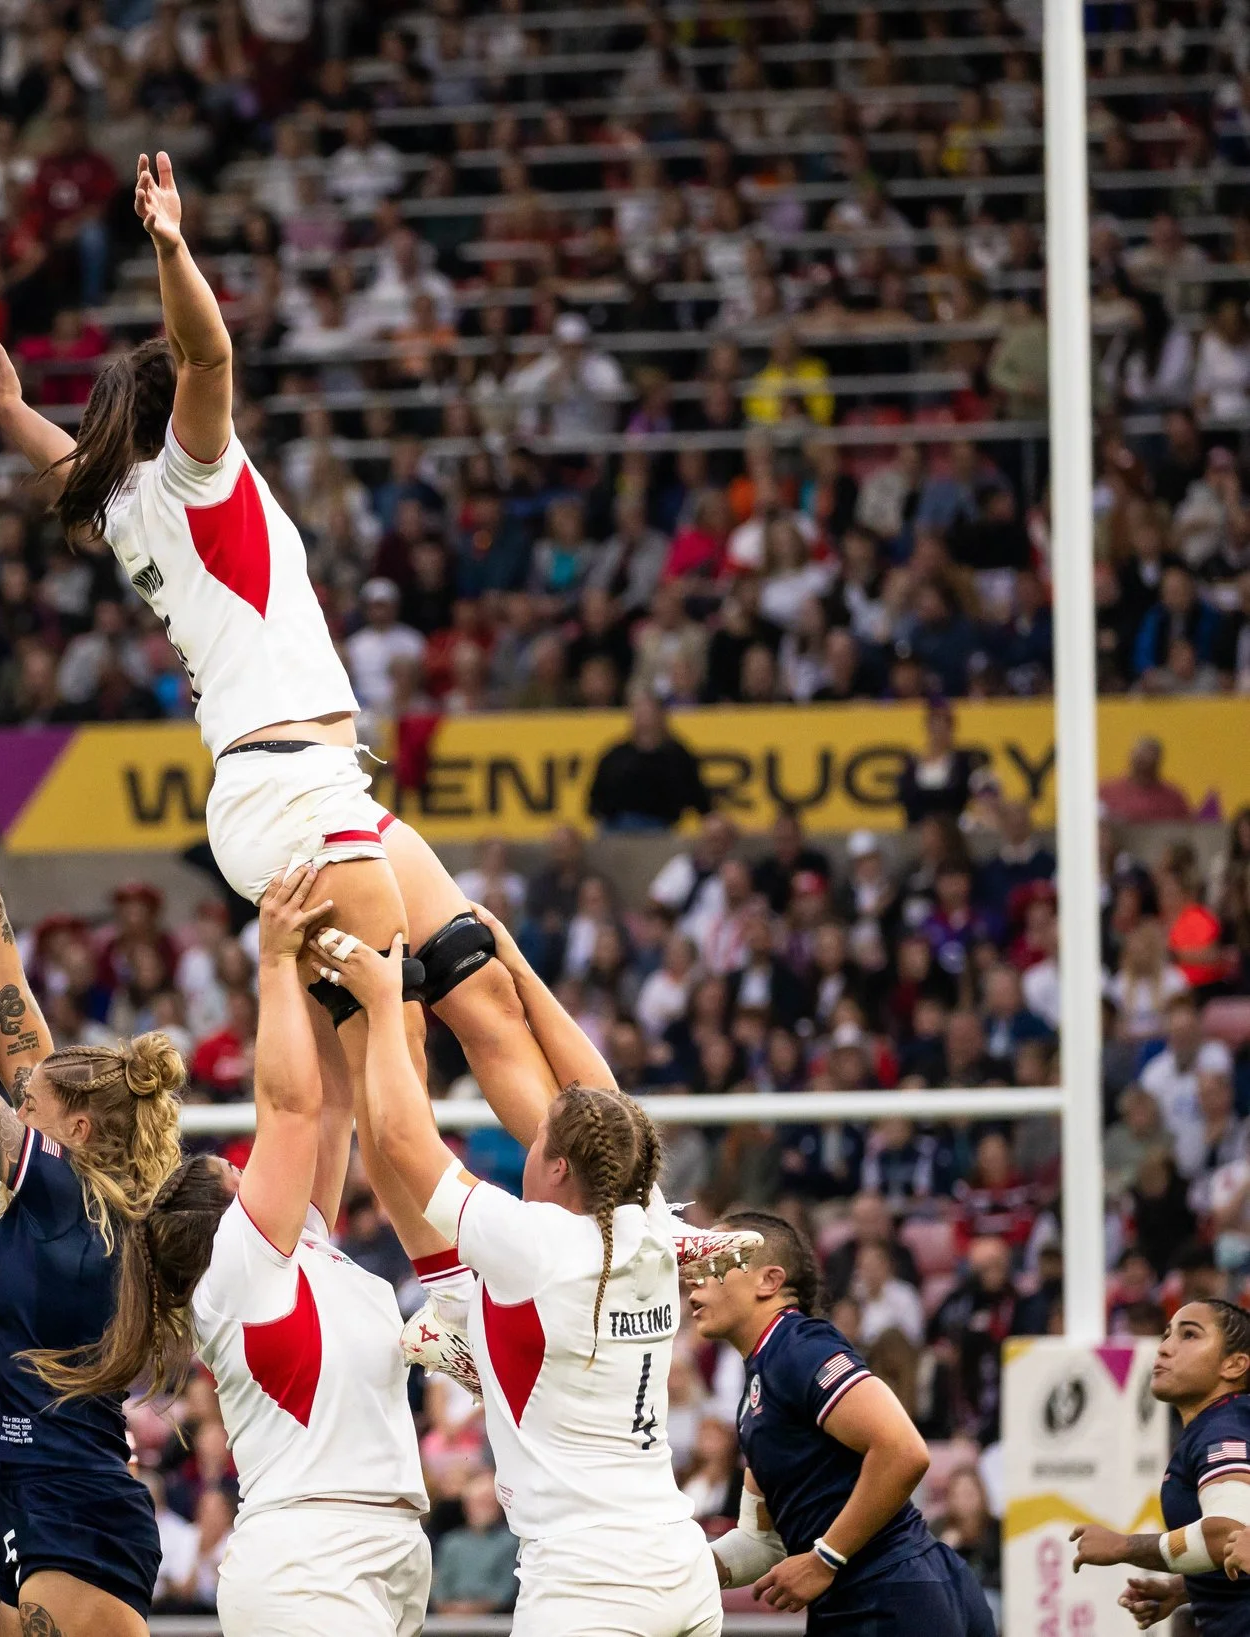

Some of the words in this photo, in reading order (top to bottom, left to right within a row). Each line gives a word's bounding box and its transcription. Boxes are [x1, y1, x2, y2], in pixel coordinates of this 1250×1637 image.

[698, 741, 1056, 808] RUGY
[609, 1303, 672, 1338] TALLING
[631, 1352, 658, 1450] 4
